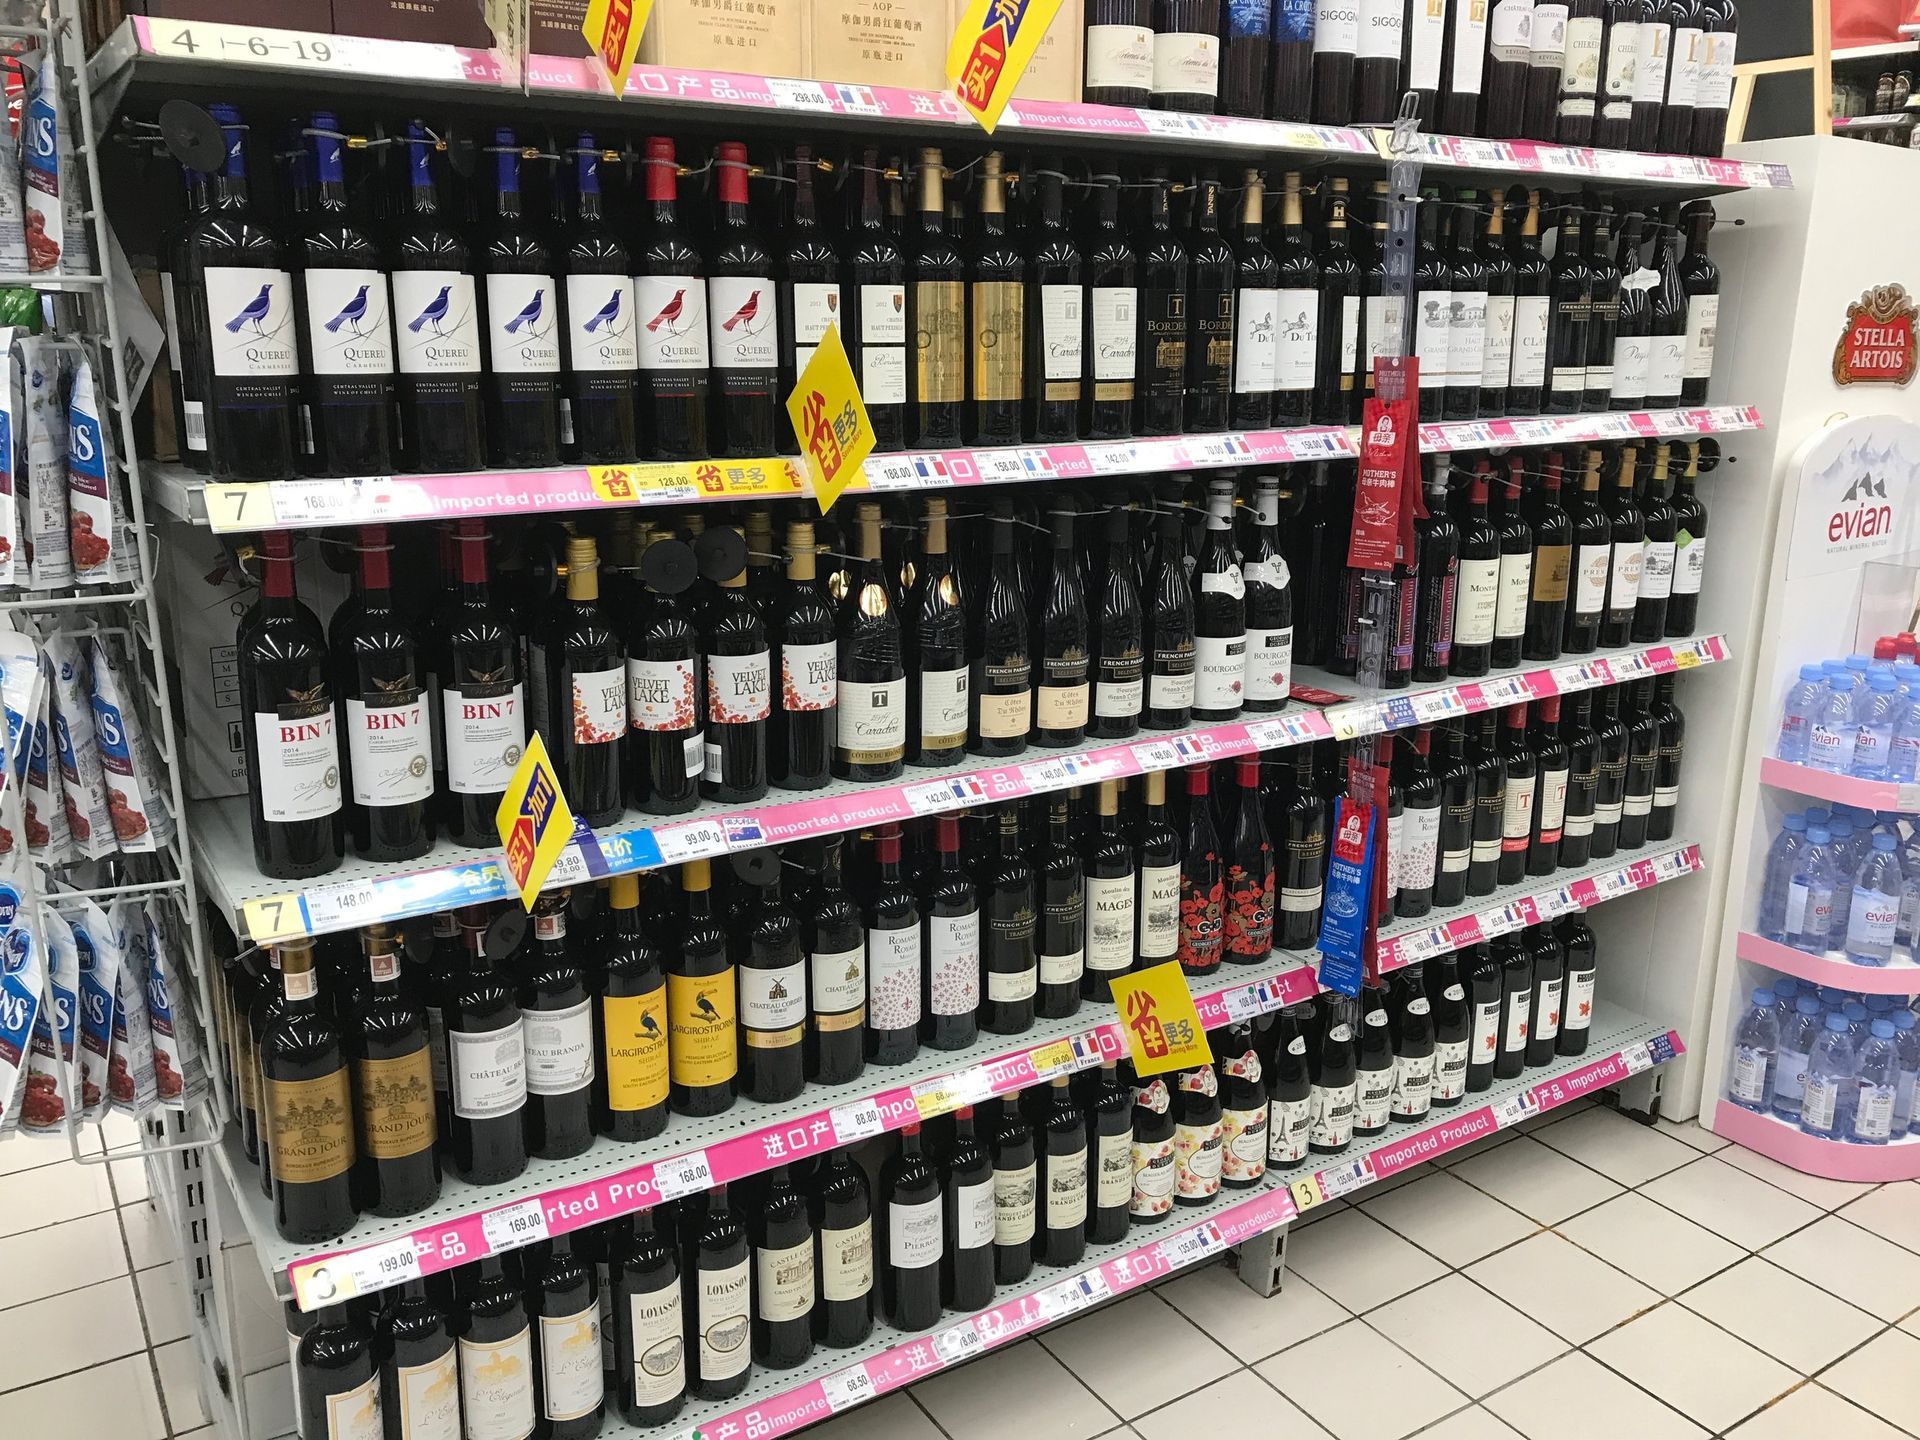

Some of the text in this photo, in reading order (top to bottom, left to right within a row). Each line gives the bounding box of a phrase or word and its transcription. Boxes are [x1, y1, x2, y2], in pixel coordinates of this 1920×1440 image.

[872, 2, 893, 11] AOP
[841, 13, 922, 31] 摩伽男爵红葡萄酒
[172, 29, 200, 53] 4
[713, 34, 757, 47] 原瓶进口
[862, 49, 903, 61] 原瓶进口
[792, 92, 824, 104] 298.00
[1021, 110, 1141, 130] Imported product
[1854, 327, 1905, 347] STELLA
[246, 348, 291, 362] QUEREU
[344, 348, 386, 361] QUEREU
[425, 346, 469, 360] QUEREU
[521, 348, 558, 360] QUEREU
[599, 346, 634, 360] QUEREU
[661, 345, 700, 357] QUEREU
[737, 345, 772, 357] QUEREU
[1850, 350, 1903, 369] ARTOIS
[832, 399, 858, 450] 更多
[1301, 439, 1323, 451] 158.00
[1372, 433, 1392, 445] 母亲
[1105, 453, 1129, 464] 142.00
[883, 467, 912, 480] 188.00
[994, 461, 1020, 472] 158.00
[658, 476, 688, 487] 128.00
[725, 467, 767, 485] 更多
[1362, 469, 1396, 480] MOTHER'S
[224, 492, 248, 521] 7
[304, 493, 343, 509] 168.00
[437, 491, 529, 510] Imported
[1828, 502, 1891, 543] evian
[1826, 539, 1887, 554] NATURAL MINERAL WATER
[732, 668, 767, 682] VELVET
[808, 670, 836, 685] LAKE
[632, 677, 670, 690] VELVET
[734, 680, 768, 696] LAKE
[633, 688, 669, 704] LAKE
[462, 700, 515, 720] BIN 7
[366, 709, 420, 731] BIN 7
[280, 718, 332, 744] BIN 7
[1811, 733, 1840, 747] evian
[1150, 749, 1172, 760] 148.00
[1040, 768, 1064, 780] 148.00
[527, 778, 554, 827] 加1
[925, 791, 951, 804] 142.00
[962, 797, 984, 805] France
[767, 801, 902, 836] Imported product
[685, 829, 711, 846] 99.00
[1343, 829, 1360, 842] 母亲
[615, 856, 634, 866] price
[558, 864, 581, 875] 78.00
[469, 881, 501, 896] Member
[336, 891, 373, 908] 148.00
[1096, 897, 1133, 912] MAGES
[261, 904, 283, 931] 7
[1866, 909, 1896, 923] evian
[749, 1001, 779, 1010] CHATEAU
[1239, 993, 1257, 1007] 108.00
[1264, 1001, 1281, 1010] France
[1163, 1019, 1195, 1046] 更多
[550, 1042, 584, 1057] BRANDA
[1169, 1043, 1198, 1055] Saving More
[1052, 1055, 1071, 1066] 69.00
[1080, 1055, 1101, 1066] France
[470, 1065, 511, 1080] CHÂTEAU
[1567, 1063, 1616, 1090] Imported
[1539, 1084, 1564, 1106] 产品
[855, 1110, 877, 1125] 88.80
[1506, 1105, 1519, 1117] 62.00
[405, 1112, 431, 1129] JOUR
[277, 1136, 347, 1156] GRAND JOUR
[762, 1120, 830, 1160] 进口产
[1380, 1115, 1489, 1169] Imported Product
[678, 1165, 708, 1184] 168.00
[1336, 1172, 1354, 1186] 135.00
[1359, 1175, 1375, 1185] France
[1300, 1183, 1312, 1205] 3
[509, 1213, 541, 1234] 169.00
[1178, 1239, 1198, 1255] 135.00
[1206, 1243, 1224, 1254] France
[378, 1251, 413, 1273] 199.00
[312, 1268, 337, 1300] 3
[846, 1375, 868, 1392] 68.50
